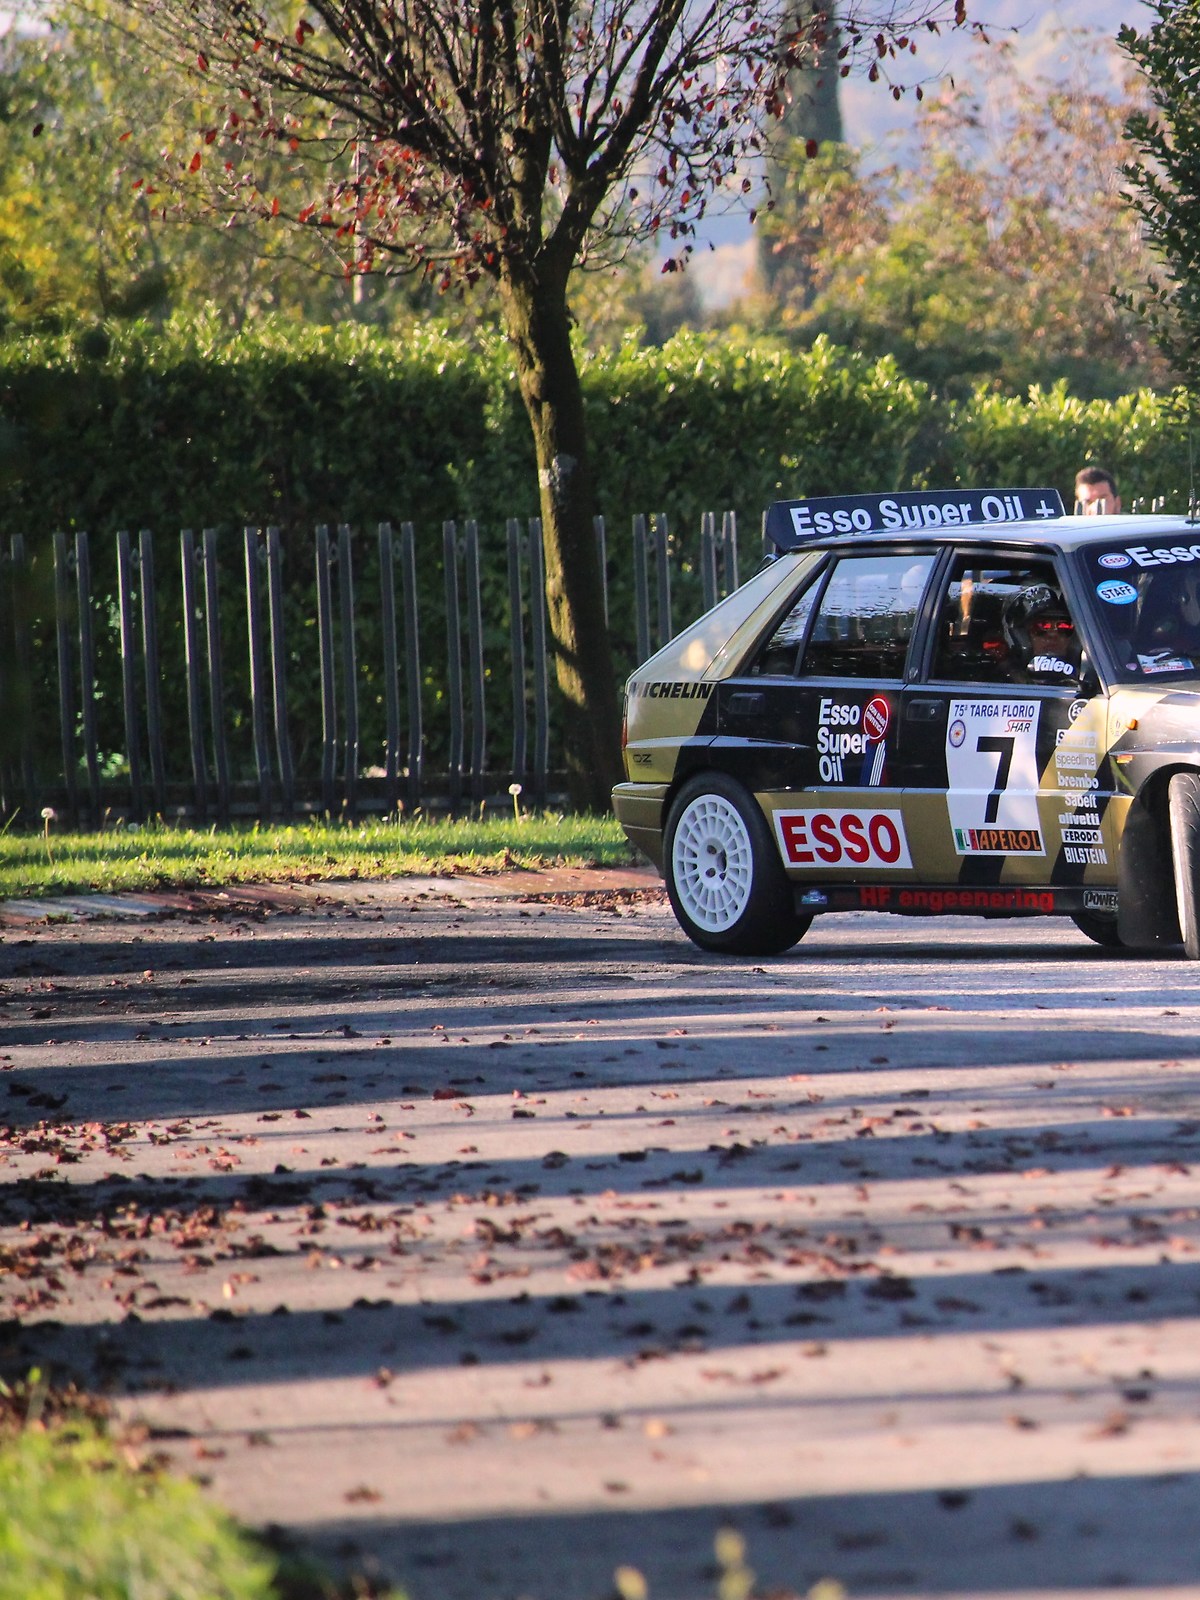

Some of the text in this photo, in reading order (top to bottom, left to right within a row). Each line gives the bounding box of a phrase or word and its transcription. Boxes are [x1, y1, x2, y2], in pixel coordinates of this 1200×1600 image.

[789, 506, 872, 535] Esso
[879, 499, 972, 529] Super
[980, 495, 1024, 521] Oil
[1101, 586, 1132, 599] STAFF
[1033, 656, 1074, 675] Valeo
[818, 698, 861, 725] Esso
[971, 704, 998, 717] TARGA
[1002, 704, 1035, 718] FLORIO
[1004, 720, 1033, 732] SHAR
[817, 726, 871, 759] Super
[819, 755, 844, 782] Oil
[976, 736, 1016, 823] 7
[1057, 772, 1099, 789] brembo
[1058, 813, 1100, 826] olivetti
[779, 813, 901, 863] ESSO
[979, 830, 1041, 850] APEROL
[1064, 831, 1098, 842] FERODO
[1063, 847, 1108, 864] BILSTEIN
[859, 886, 1055, 912] HF engeenering
